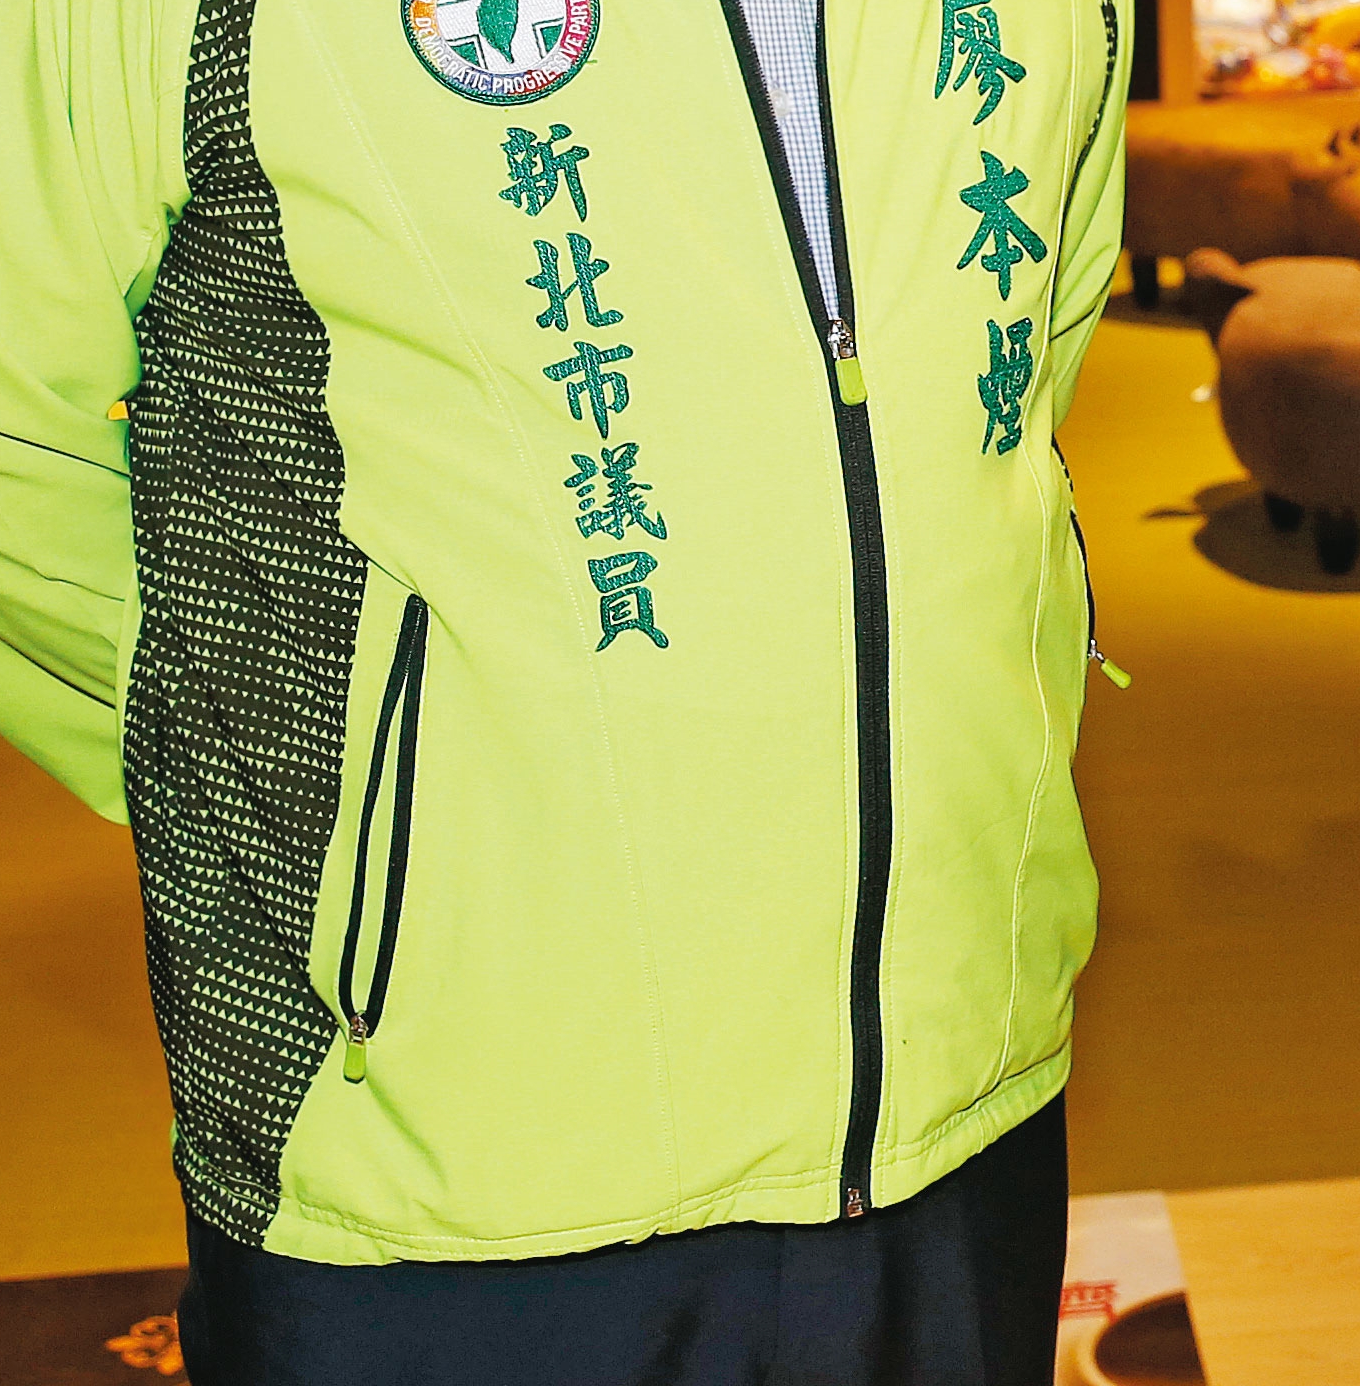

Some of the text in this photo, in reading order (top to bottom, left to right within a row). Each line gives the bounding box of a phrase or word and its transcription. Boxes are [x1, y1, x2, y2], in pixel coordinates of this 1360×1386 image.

[414, 17, 490, 91] DEMOCRATIC
[492, 35, 581, 94] PROGRESSIVE
[498, 123, 670, 653] 新北市議員
